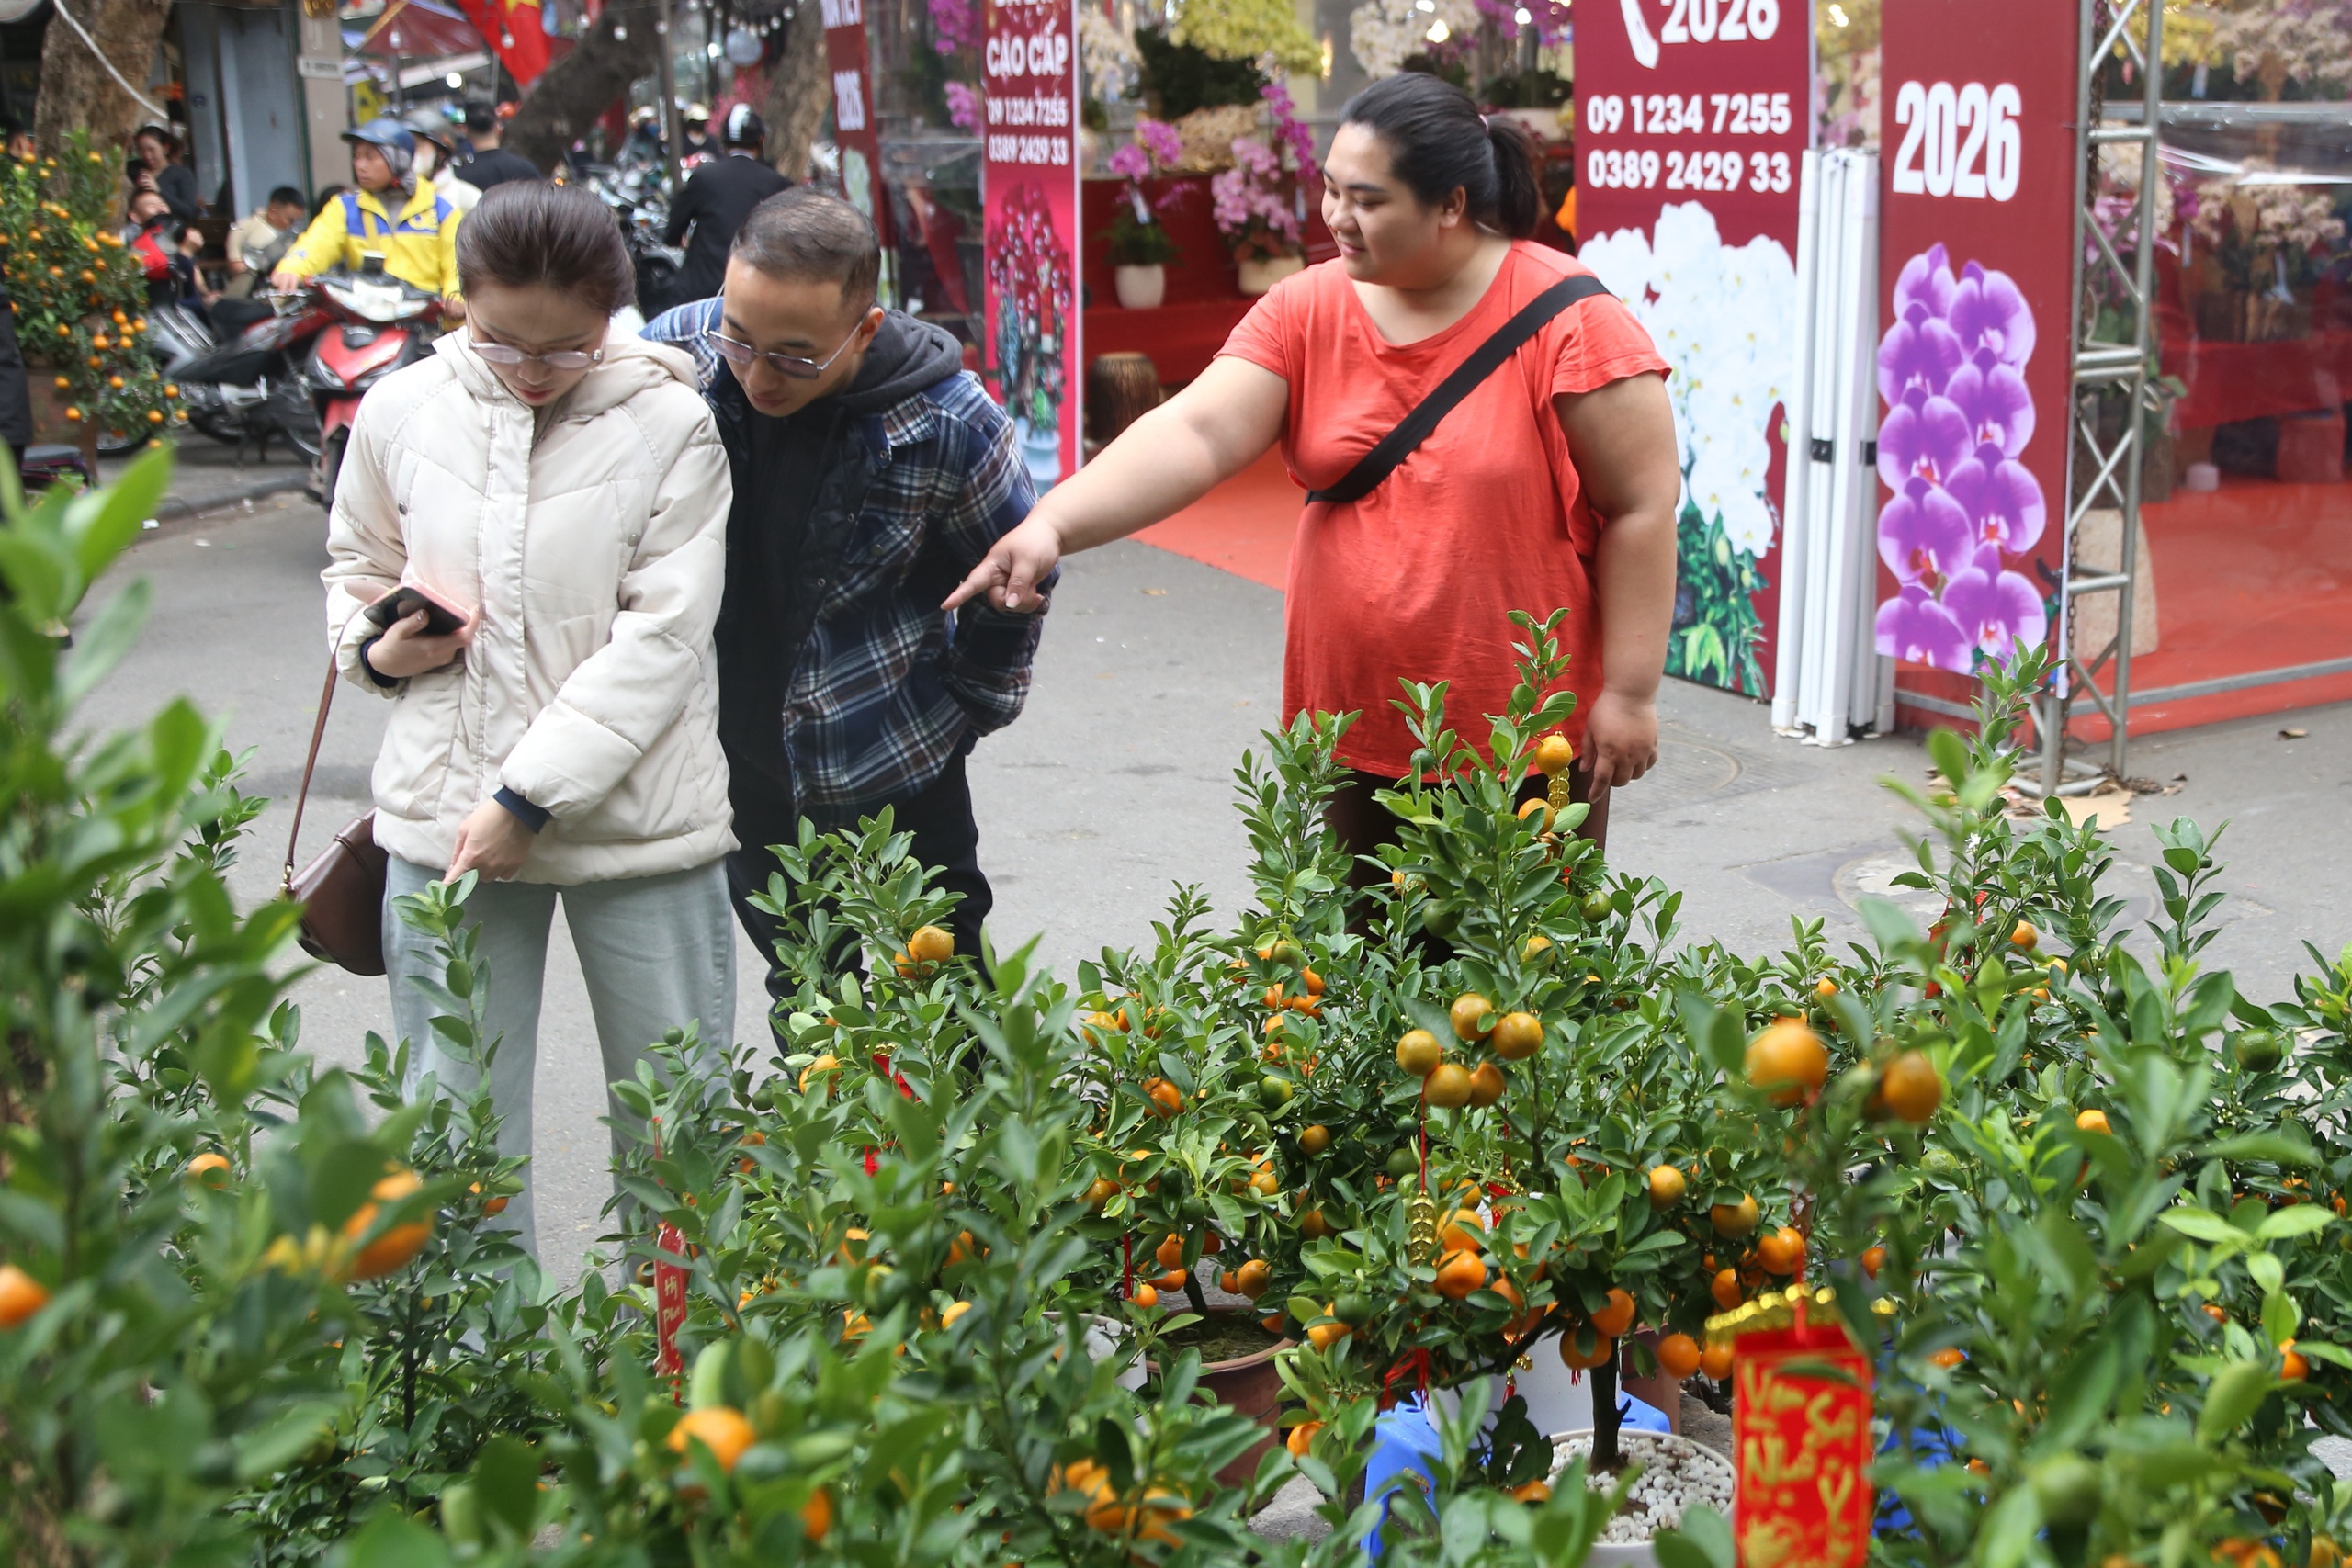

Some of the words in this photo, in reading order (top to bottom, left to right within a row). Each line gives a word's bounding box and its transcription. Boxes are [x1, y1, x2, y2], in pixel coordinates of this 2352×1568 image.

[1660, 0, 1780, 44] 2026
[986, 35, 1026, 77] CAO
[987, 97, 1004, 125] 09
[1005, 96, 1035, 126] 1234
[1035, 96, 1069, 127] 7255
[1587, 94, 1623, 134] 09
[1631, 93, 1704, 134] 1234
[1710, 93, 1792, 135] 7255
[988, 134, 1018, 163] 0389
[1018, 135, 1050, 164] 2429
[1050, 137, 1069, 166] 33
[1893, 80, 2021, 203] 2026
[1587, 149, 1660, 190] 0389
[1666, 150, 1744, 191] 2429
[1749, 151, 1792, 194] 33
